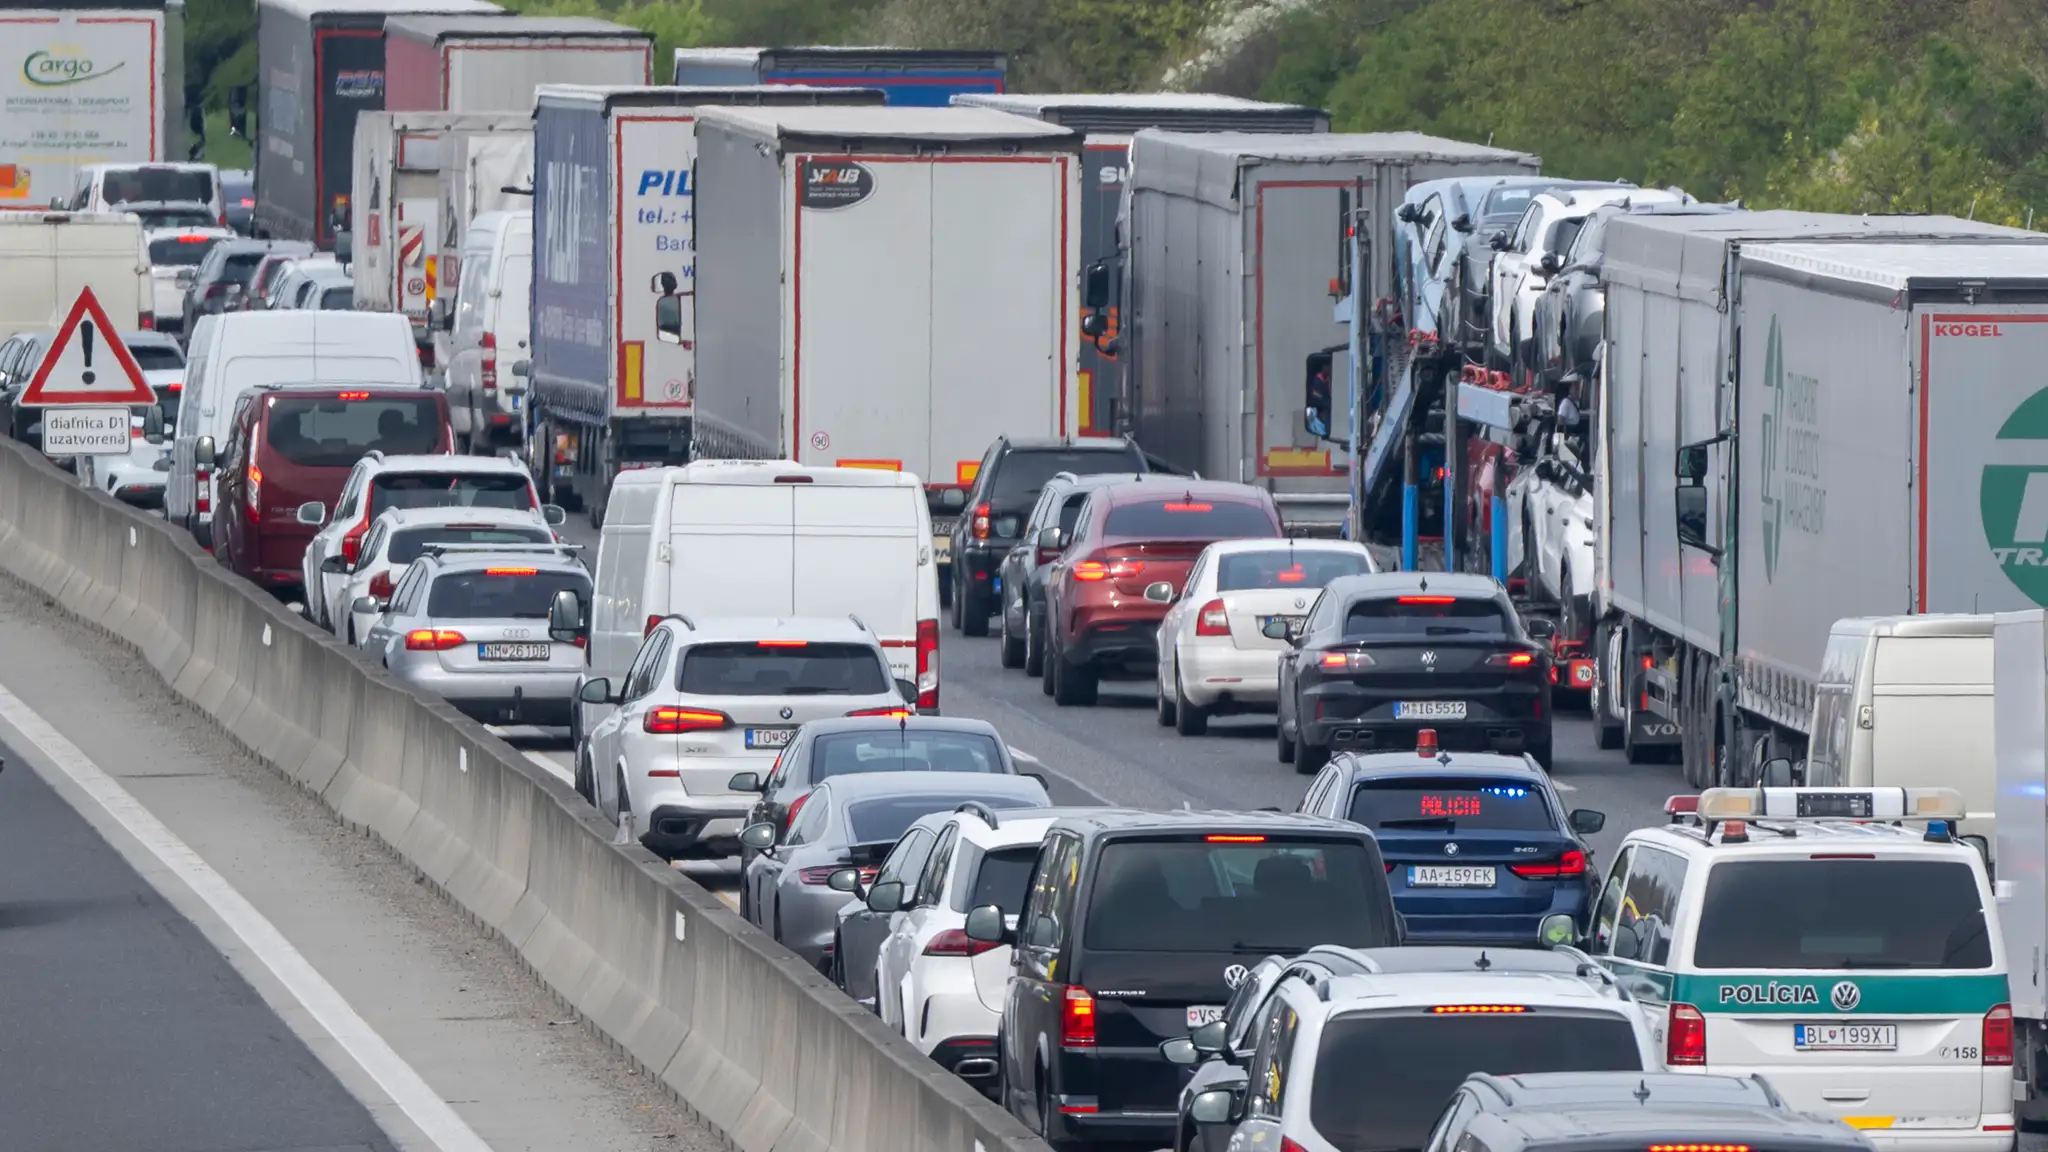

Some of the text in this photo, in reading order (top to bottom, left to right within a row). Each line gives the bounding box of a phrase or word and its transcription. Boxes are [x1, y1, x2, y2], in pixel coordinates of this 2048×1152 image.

[24, 51, 124, 86] Cargo
[1935, 324, 2003, 337] KÖGEL
[109, 417, 124, 429] D1
[49, 432, 126, 445] uzatvorená
[814, 436, 827, 447] 90
[1992, 548, 2048, 566] TR
[1580, 669, 1591, 678] 70
[1719, 981, 1819, 1004] POLÍCIA
[1807, 1027, 1828, 1044] BL
[1954, 1047, 1978, 1059] 158
